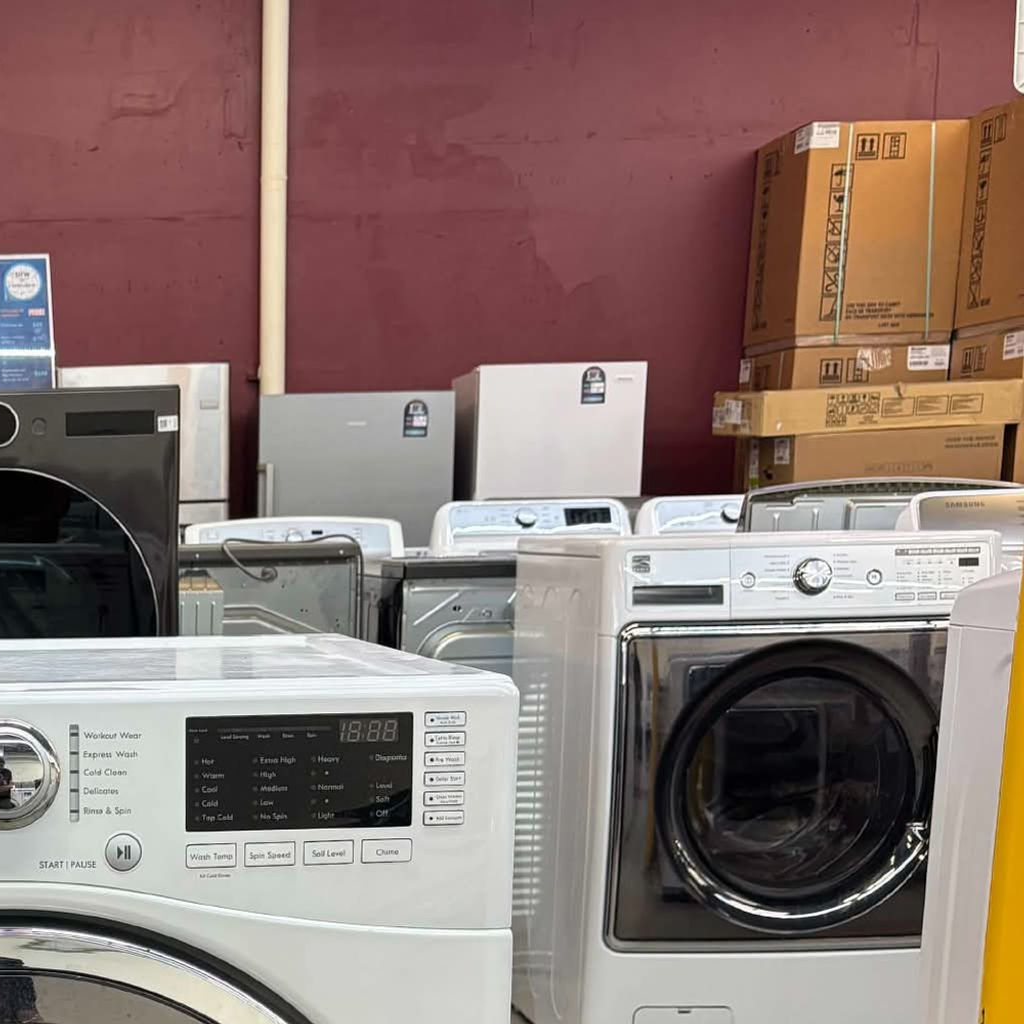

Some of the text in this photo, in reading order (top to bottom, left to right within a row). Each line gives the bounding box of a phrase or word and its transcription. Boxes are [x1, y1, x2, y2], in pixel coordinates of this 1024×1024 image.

[84, 731, 142, 740] Workout Wear
[83, 749, 138, 760] Express Wash
[318, 755, 340, 763] Heavy
[260, 756, 296, 765] Extra High
[83, 768, 127, 777] Cold Clean
[260, 771, 276, 780] High
[83, 787, 118, 796] Delicates
[83, 807, 103, 815] Rinse
[114, 807, 131, 817] Spin
[318, 811, 335, 820] Light
[376, 809, 388, 817] Off
[202, 813, 233, 822] Tap Cold
[273, 813, 288, 821] Spin
[190, 852, 233, 862] Wash Temp
[249, 851, 291, 860] Spin Speed
[311, 849, 346, 858] Soil Level
[375, 848, 399, 857] Chime
[39, 860, 97, 870] START PAUSE
